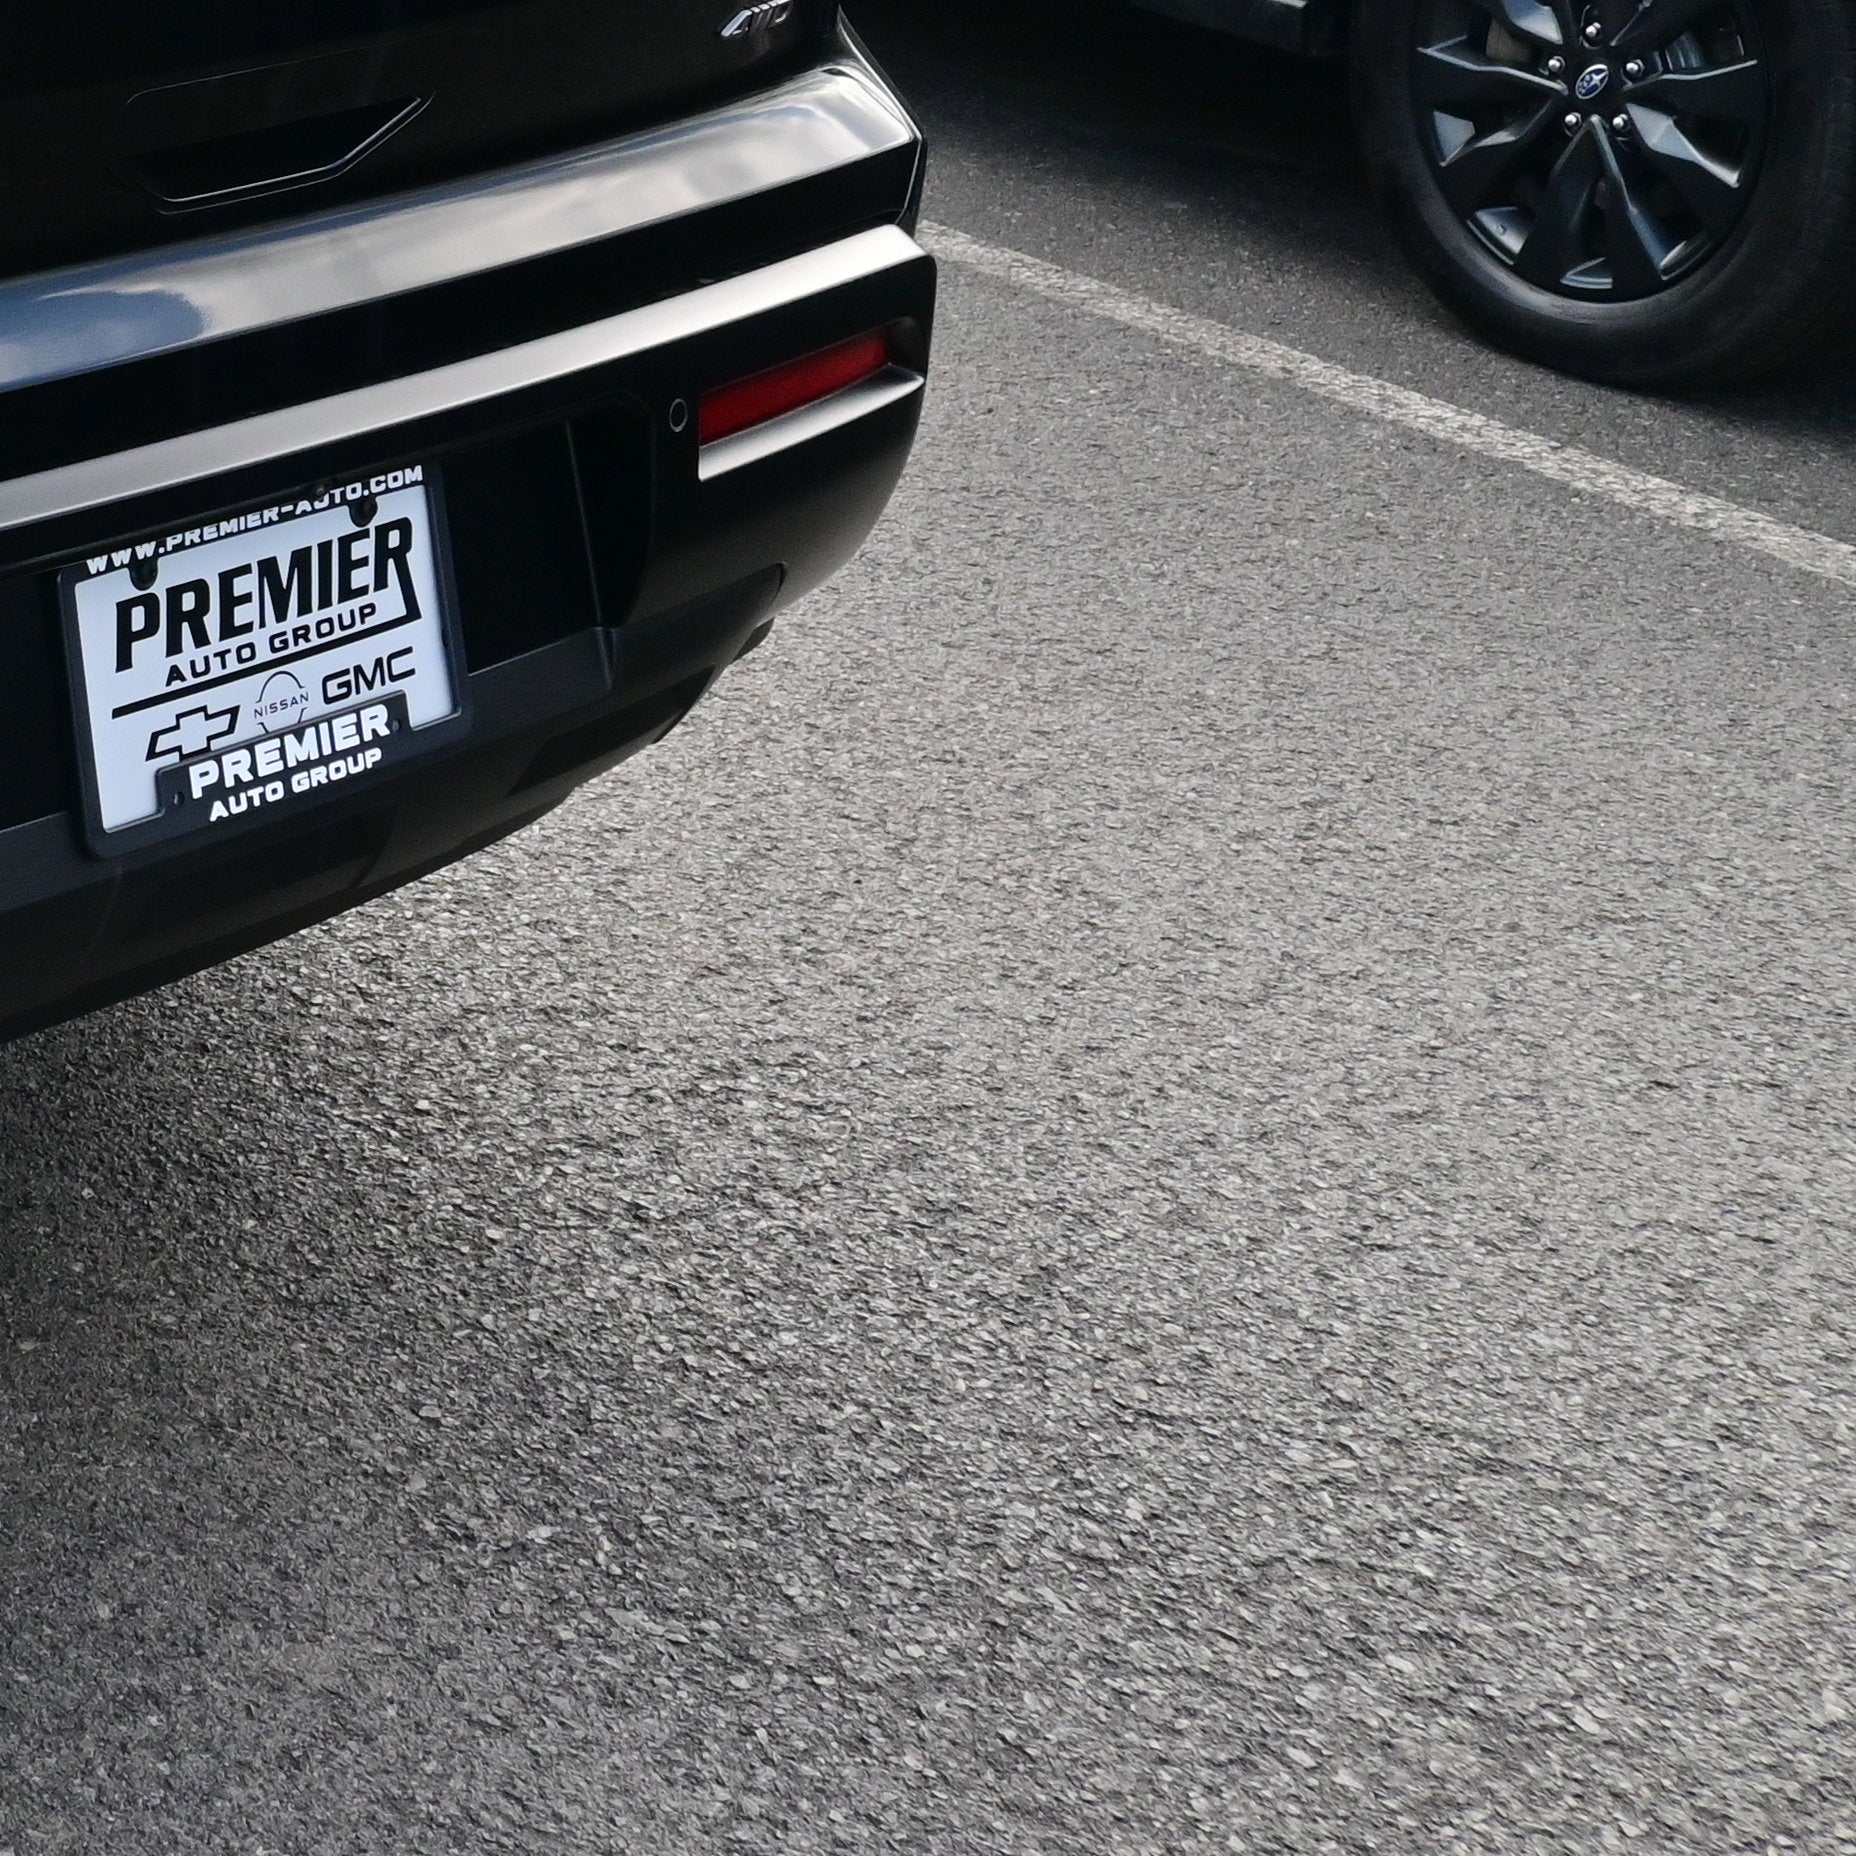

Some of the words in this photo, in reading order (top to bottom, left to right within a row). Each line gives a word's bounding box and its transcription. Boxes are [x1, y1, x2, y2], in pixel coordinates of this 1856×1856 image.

[115, 515, 422, 673] PREMIER
[164, 642, 257, 687] AUTO
[268, 602, 378, 653] GROUP
[321, 645, 417, 704] GMC
[253, 690, 310, 720] NISSAN
[187, 703, 392, 800] PREMIER
[208, 780, 283, 822] AUTO
[291, 746, 383, 794] GROUP
